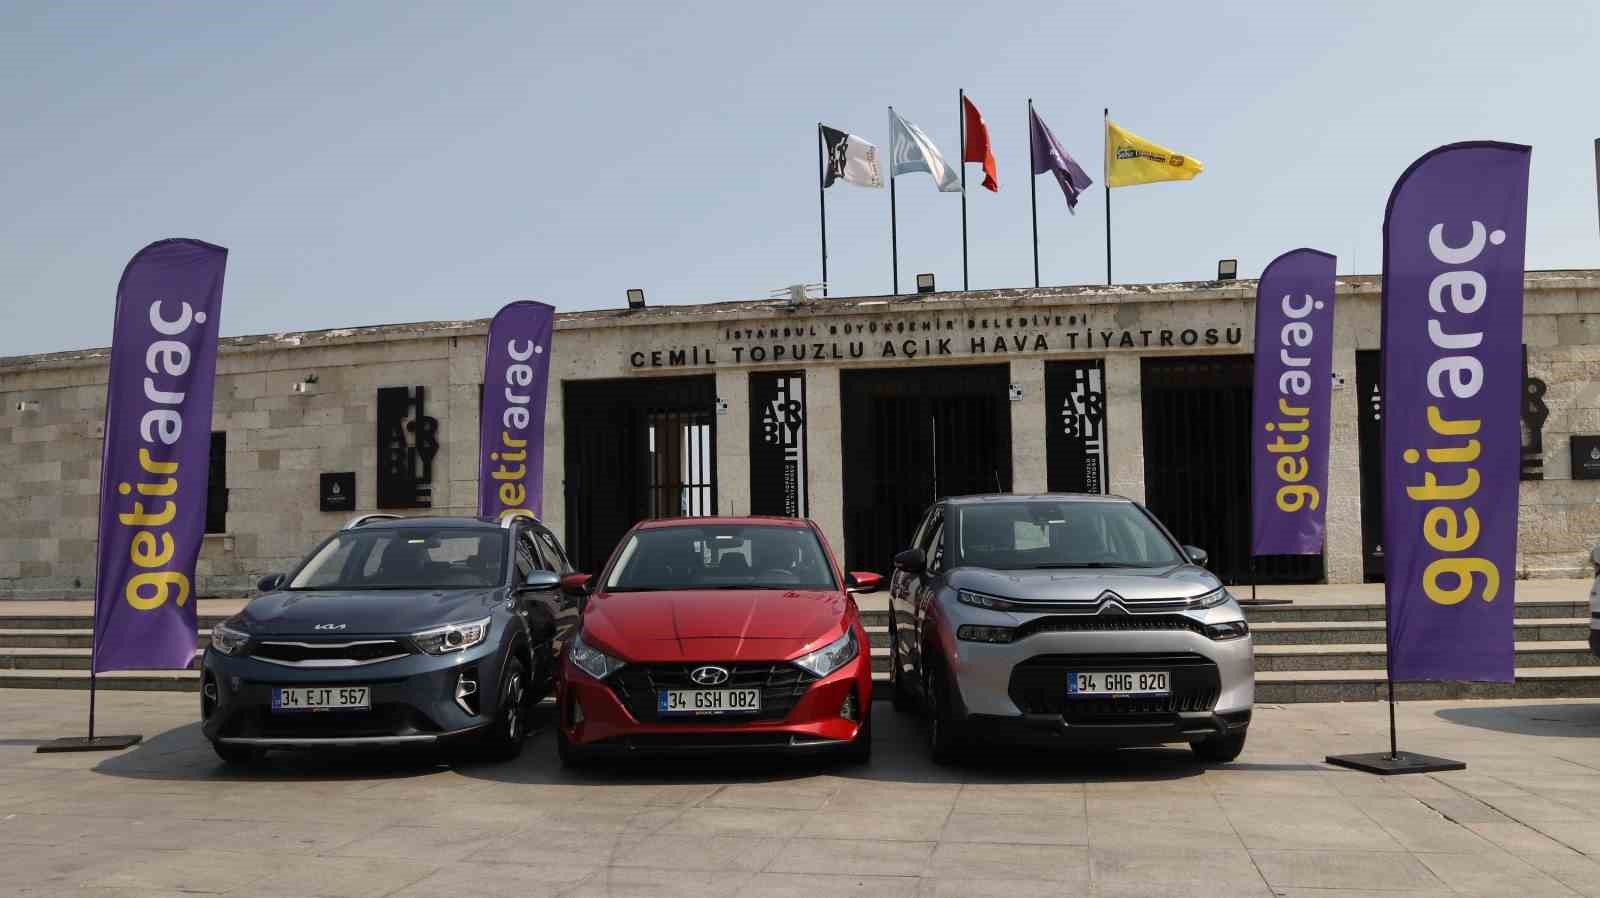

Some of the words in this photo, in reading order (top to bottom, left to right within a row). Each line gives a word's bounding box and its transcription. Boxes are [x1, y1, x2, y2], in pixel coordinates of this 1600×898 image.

[726, 327, 816, 340] İSTANBUL
[968, 313, 1086, 330] BELEDİYESİ
[630, 346, 716, 367] CEMİL
[732, 341, 863, 363] TOPUZLU
[882, 338, 951, 358] AÇIK
[971, 334, 1048, 354] HAVA
[1066, 328, 1242, 349] TİYATROSU
[1265, 294, 1324, 512] getiraraç
[1403, 220, 1506, 605] getiraraç
[118, 300, 206, 610] getiraraç
[282, 690, 298, 706] 34
[306, 690, 333, 705] EJT
[340, 689, 366, 705] 567
[1078, 675, 1096, 690] 34
[1105, 674, 1132, 690] GHG
[1139, 674, 1166, 690] 820
[669, 692, 686, 708] 34
[695, 691, 722, 708] GSH
[729, 691, 756, 707] 082
